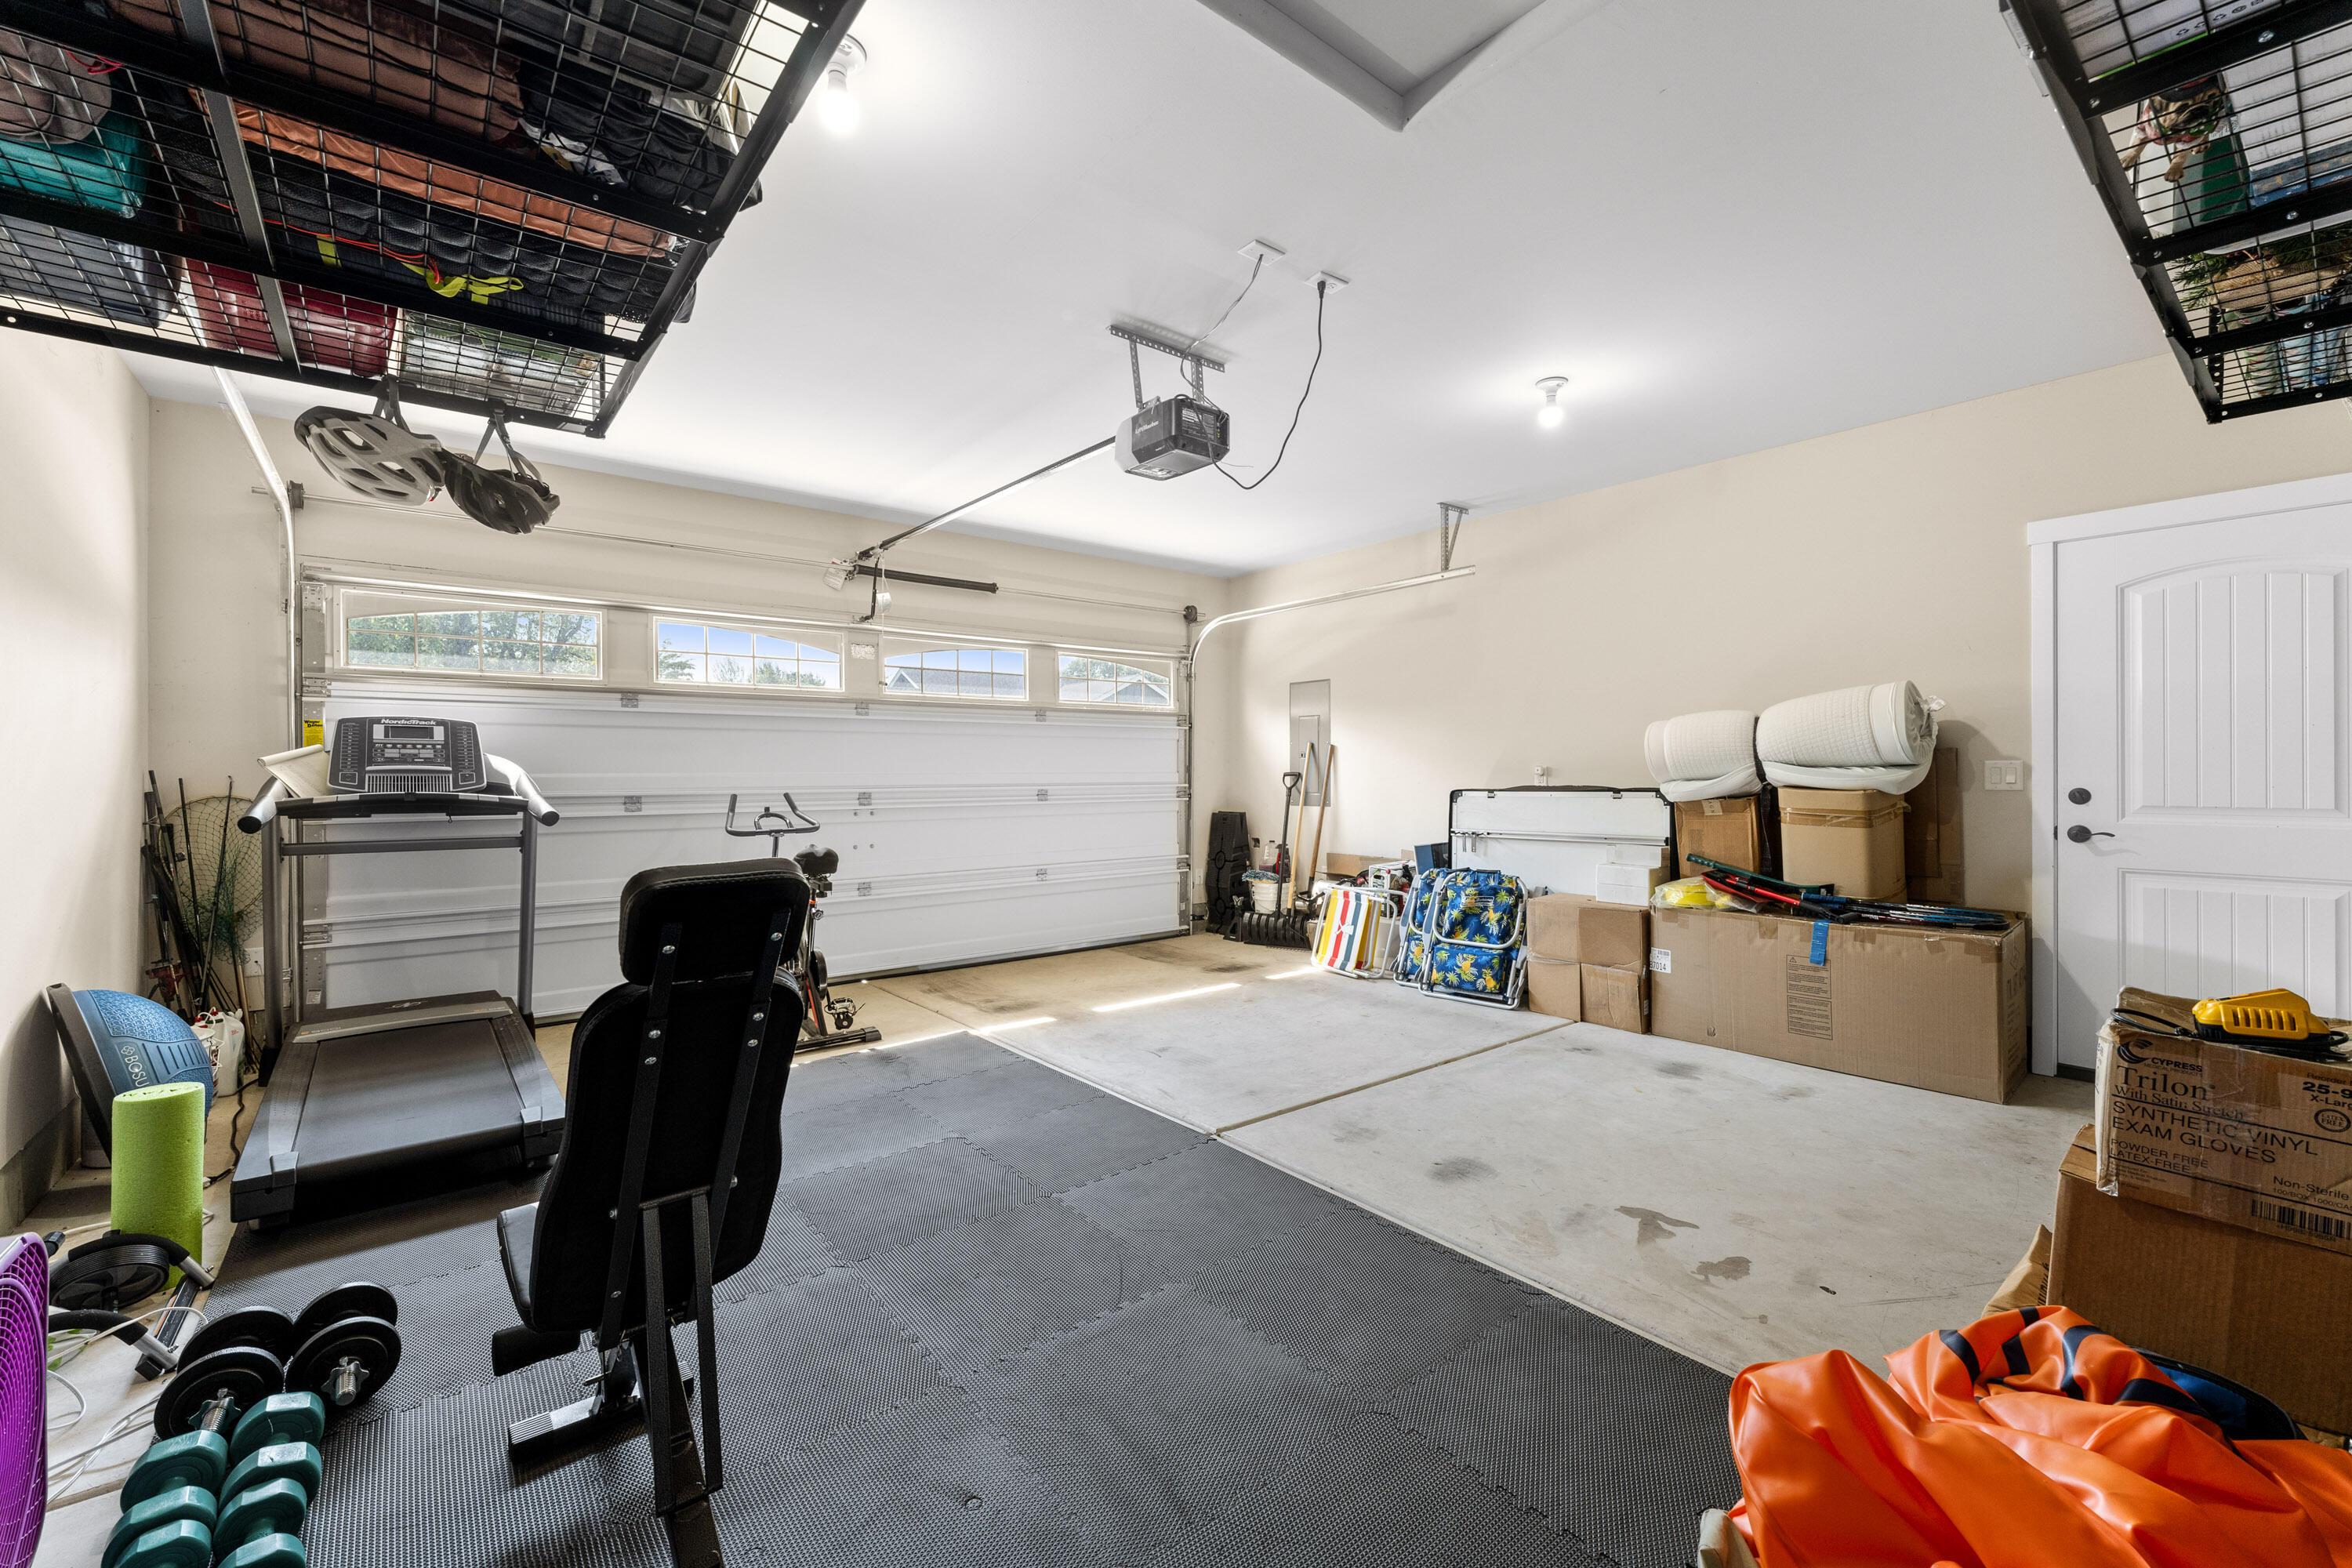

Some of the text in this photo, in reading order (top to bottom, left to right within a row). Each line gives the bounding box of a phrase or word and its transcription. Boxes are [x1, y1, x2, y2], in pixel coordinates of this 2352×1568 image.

[125, 1055, 150, 1087] BOSU
[2151, 1058, 2203, 1072] CYPRESS
[2307, 1073, 2347, 1085] Reorder
[2115, 1085, 2243, 1120] With Satin Stretch
[2113, 1101, 2318, 1156] SYNTHETIC VINYL
[2321, 1113, 2344, 1122] LATEX
[2321, 1118, 2344, 1127] FREE
[2113, 1116, 2276, 1163] EXAM GLOVES
[2111, 1138, 2209, 1168] POWDER FREE
[2111, 1148, 2190, 1174] LATEX-FREE
[2274, 1176, 2349, 1200] Non-Sterile
